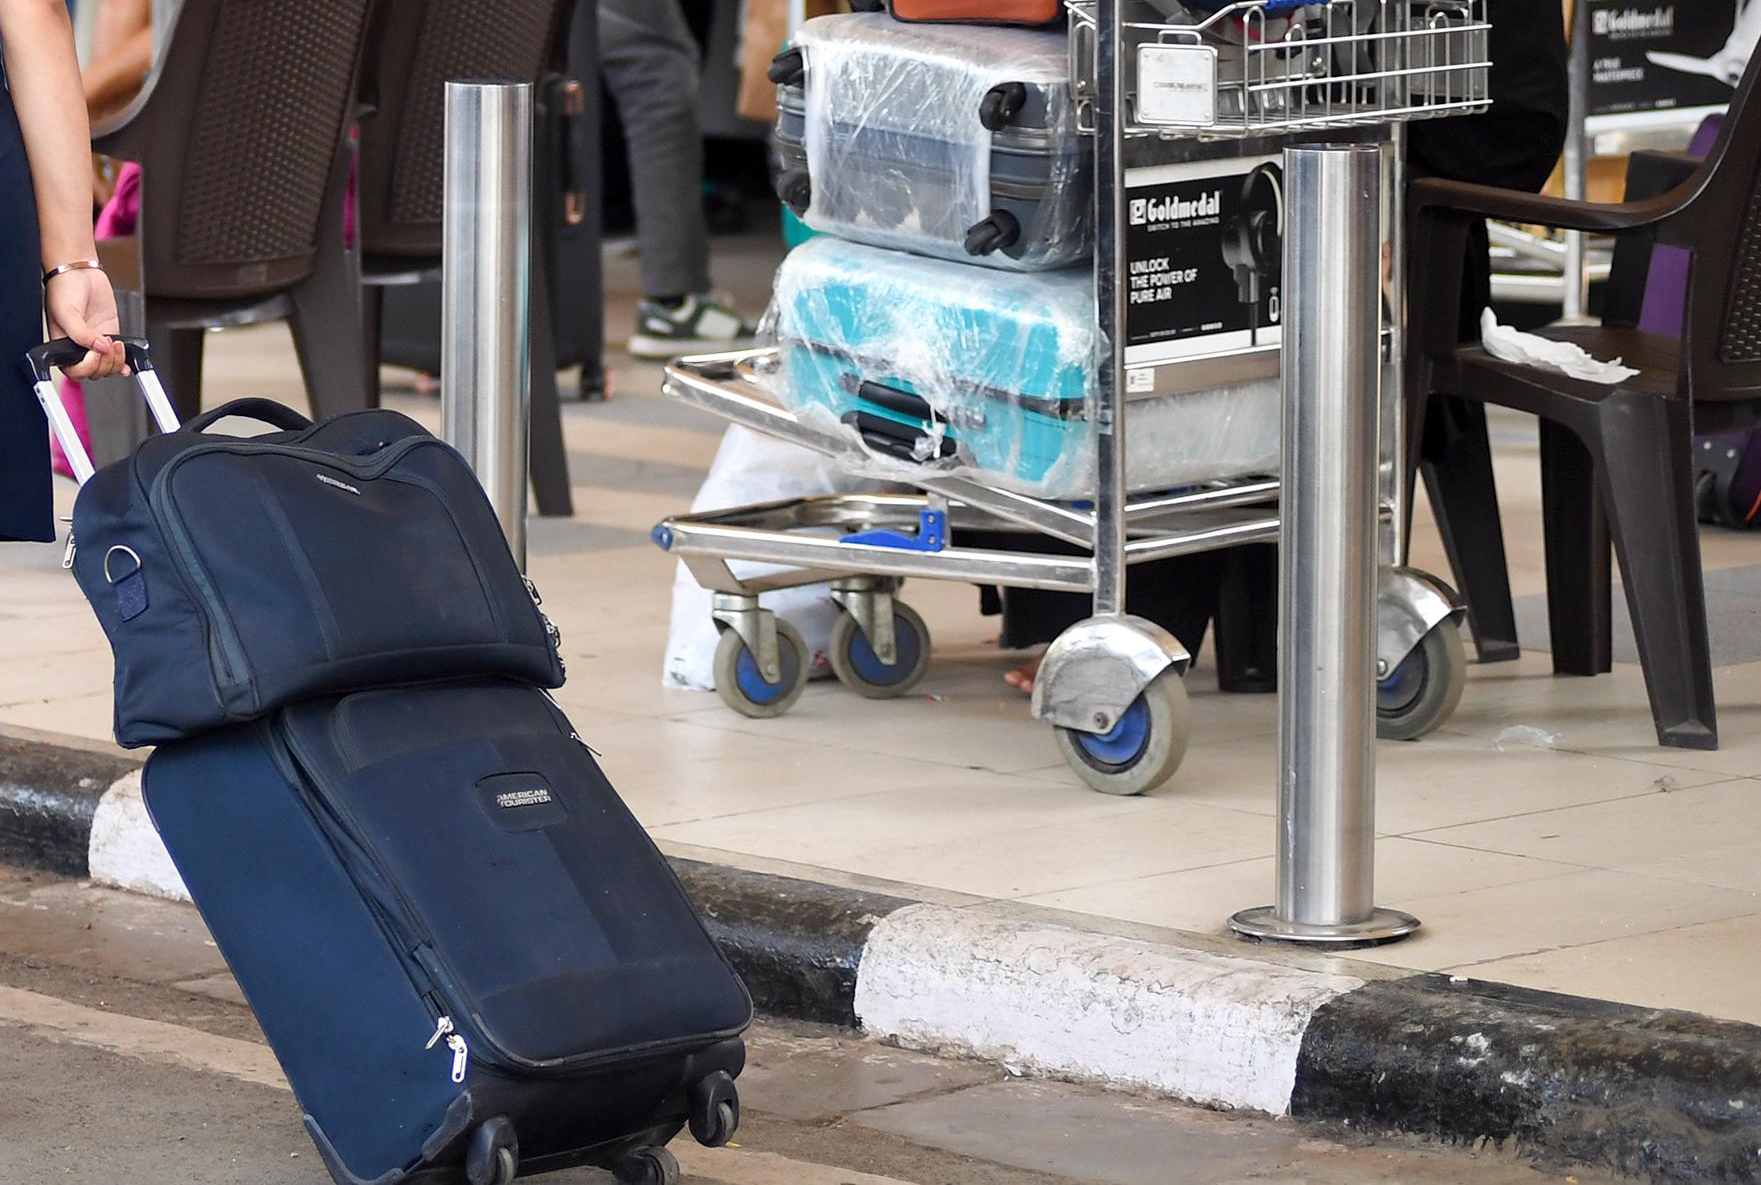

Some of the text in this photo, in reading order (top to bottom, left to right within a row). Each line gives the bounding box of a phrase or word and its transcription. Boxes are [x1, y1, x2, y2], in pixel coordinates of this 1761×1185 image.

[1147, 191, 1220, 222] Goldmedal
[1129, 257, 1170, 275] UNLOCK
[1130, 268, 1198, 289] THE POWER OF
[1130, 286, 1172, 304] PURE AIR
[497, 789, 548, 802] AMERICAN
[501, 795, 552, 808] TOURISTER
